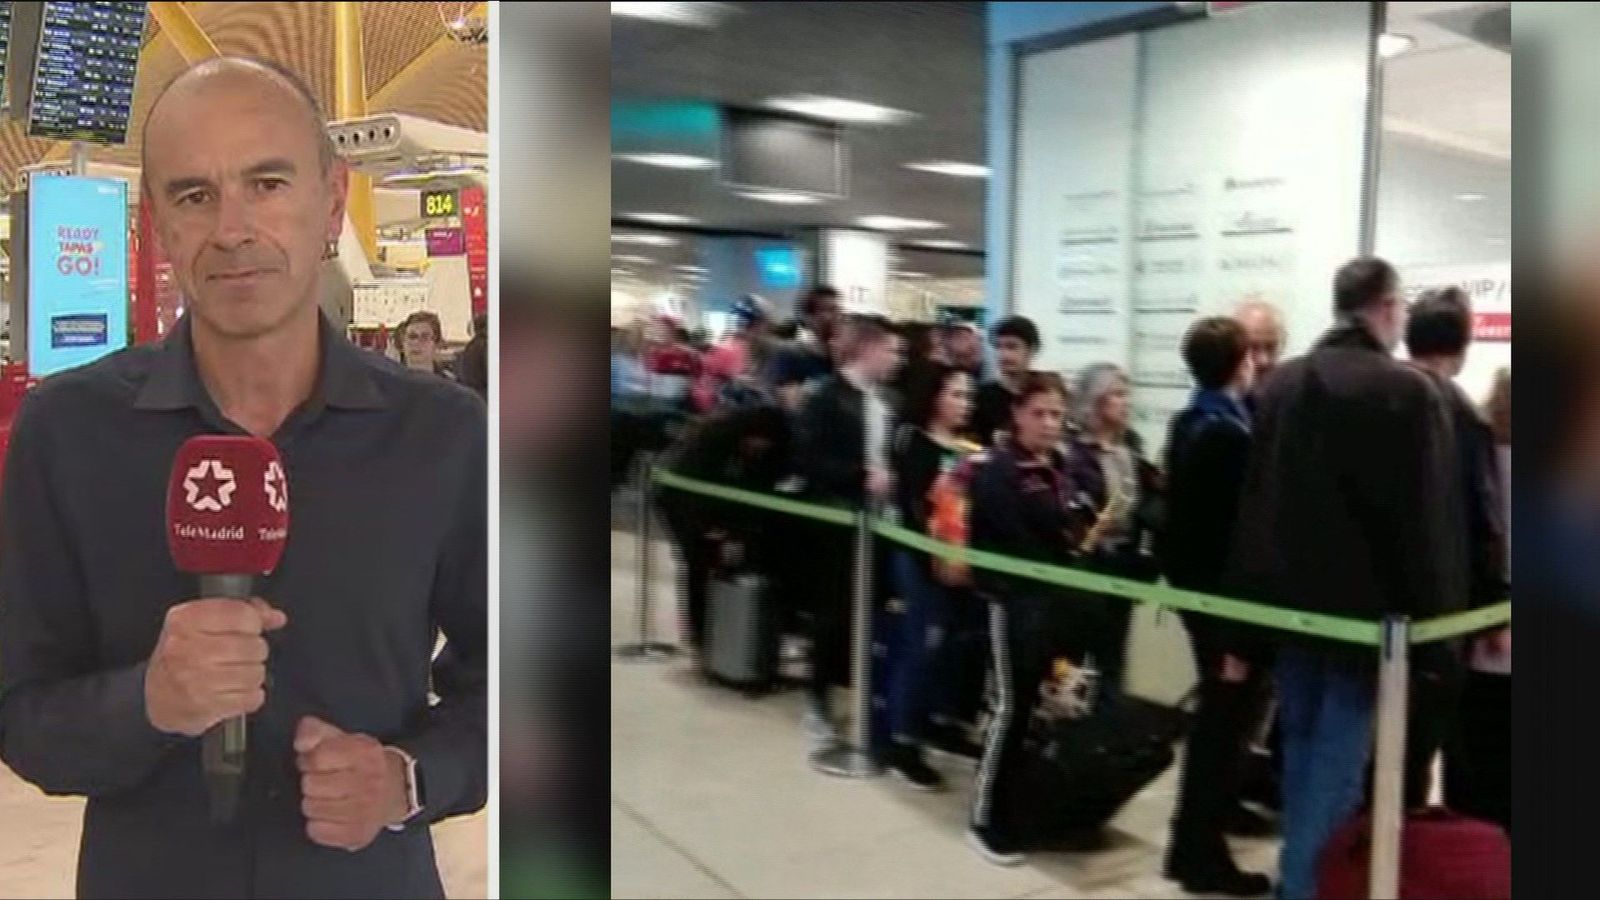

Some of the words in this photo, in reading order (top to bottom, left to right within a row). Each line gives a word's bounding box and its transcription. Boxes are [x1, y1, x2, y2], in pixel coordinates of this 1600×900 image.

[426, 194, 452, 215] 814
[58, 226, 99, 240] READY
[57, 256, 99, 276] GO!
[174, 523, 244, 539] TeleMadrid
